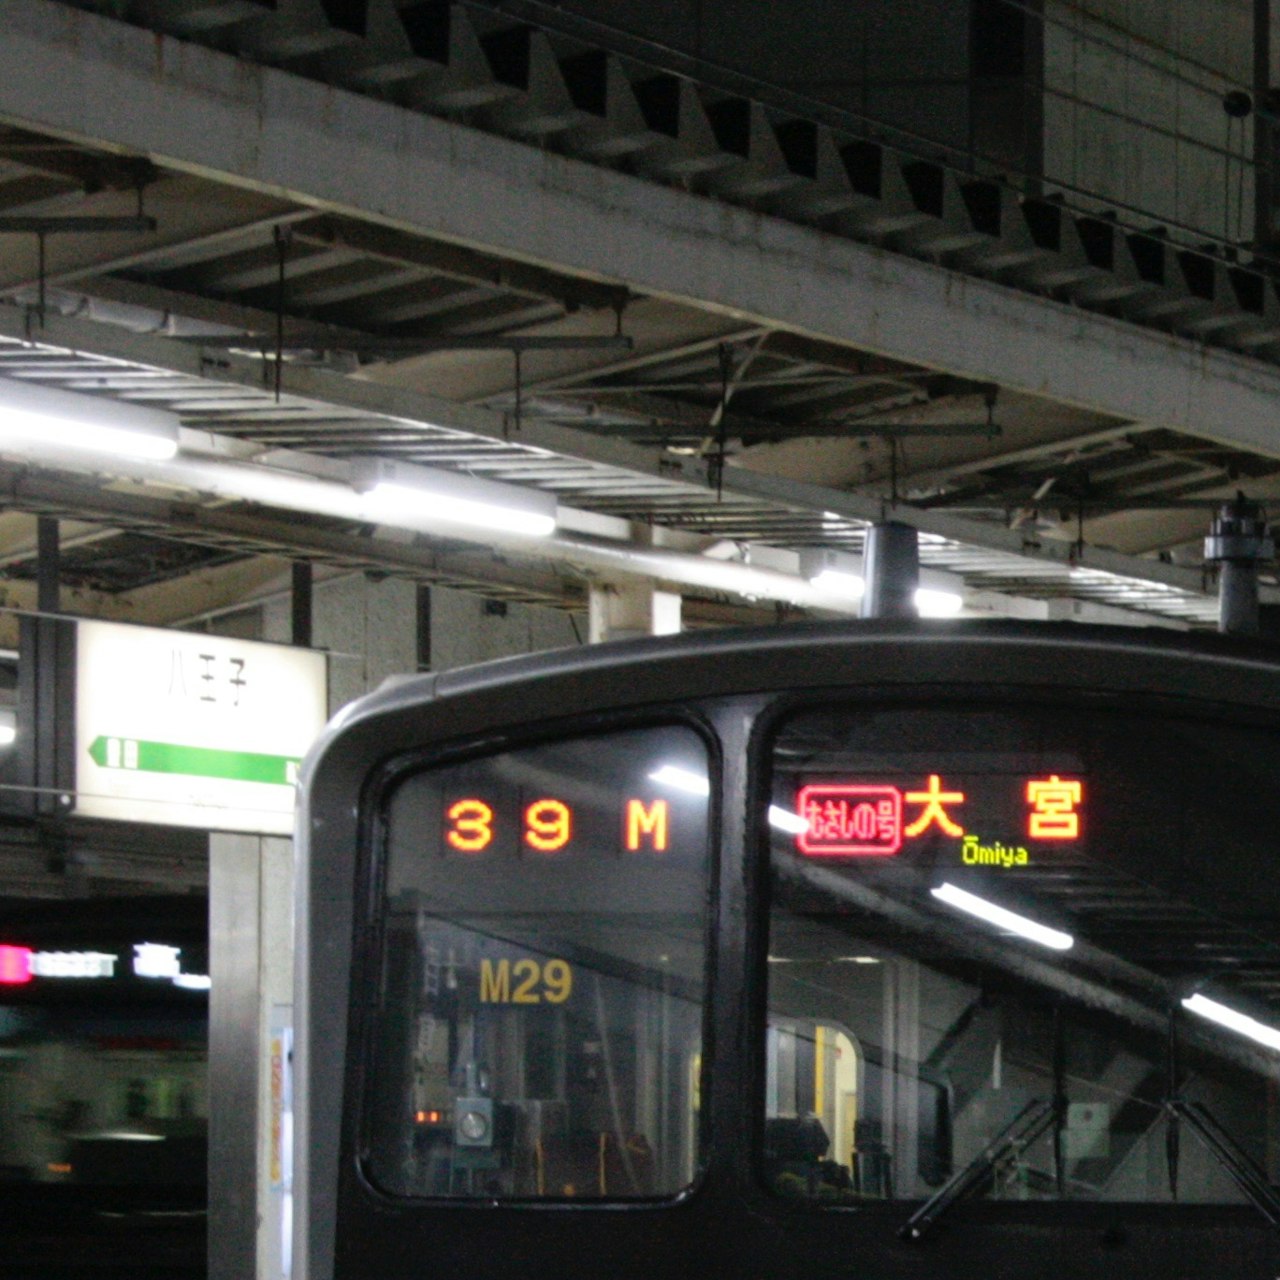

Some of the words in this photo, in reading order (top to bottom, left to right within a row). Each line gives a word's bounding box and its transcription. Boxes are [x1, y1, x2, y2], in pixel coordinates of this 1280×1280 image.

[168, 648, 247, 707] 八王子
[807, 800, 895, 840] むさしの号
[479, 958, 573, 1004] M29
